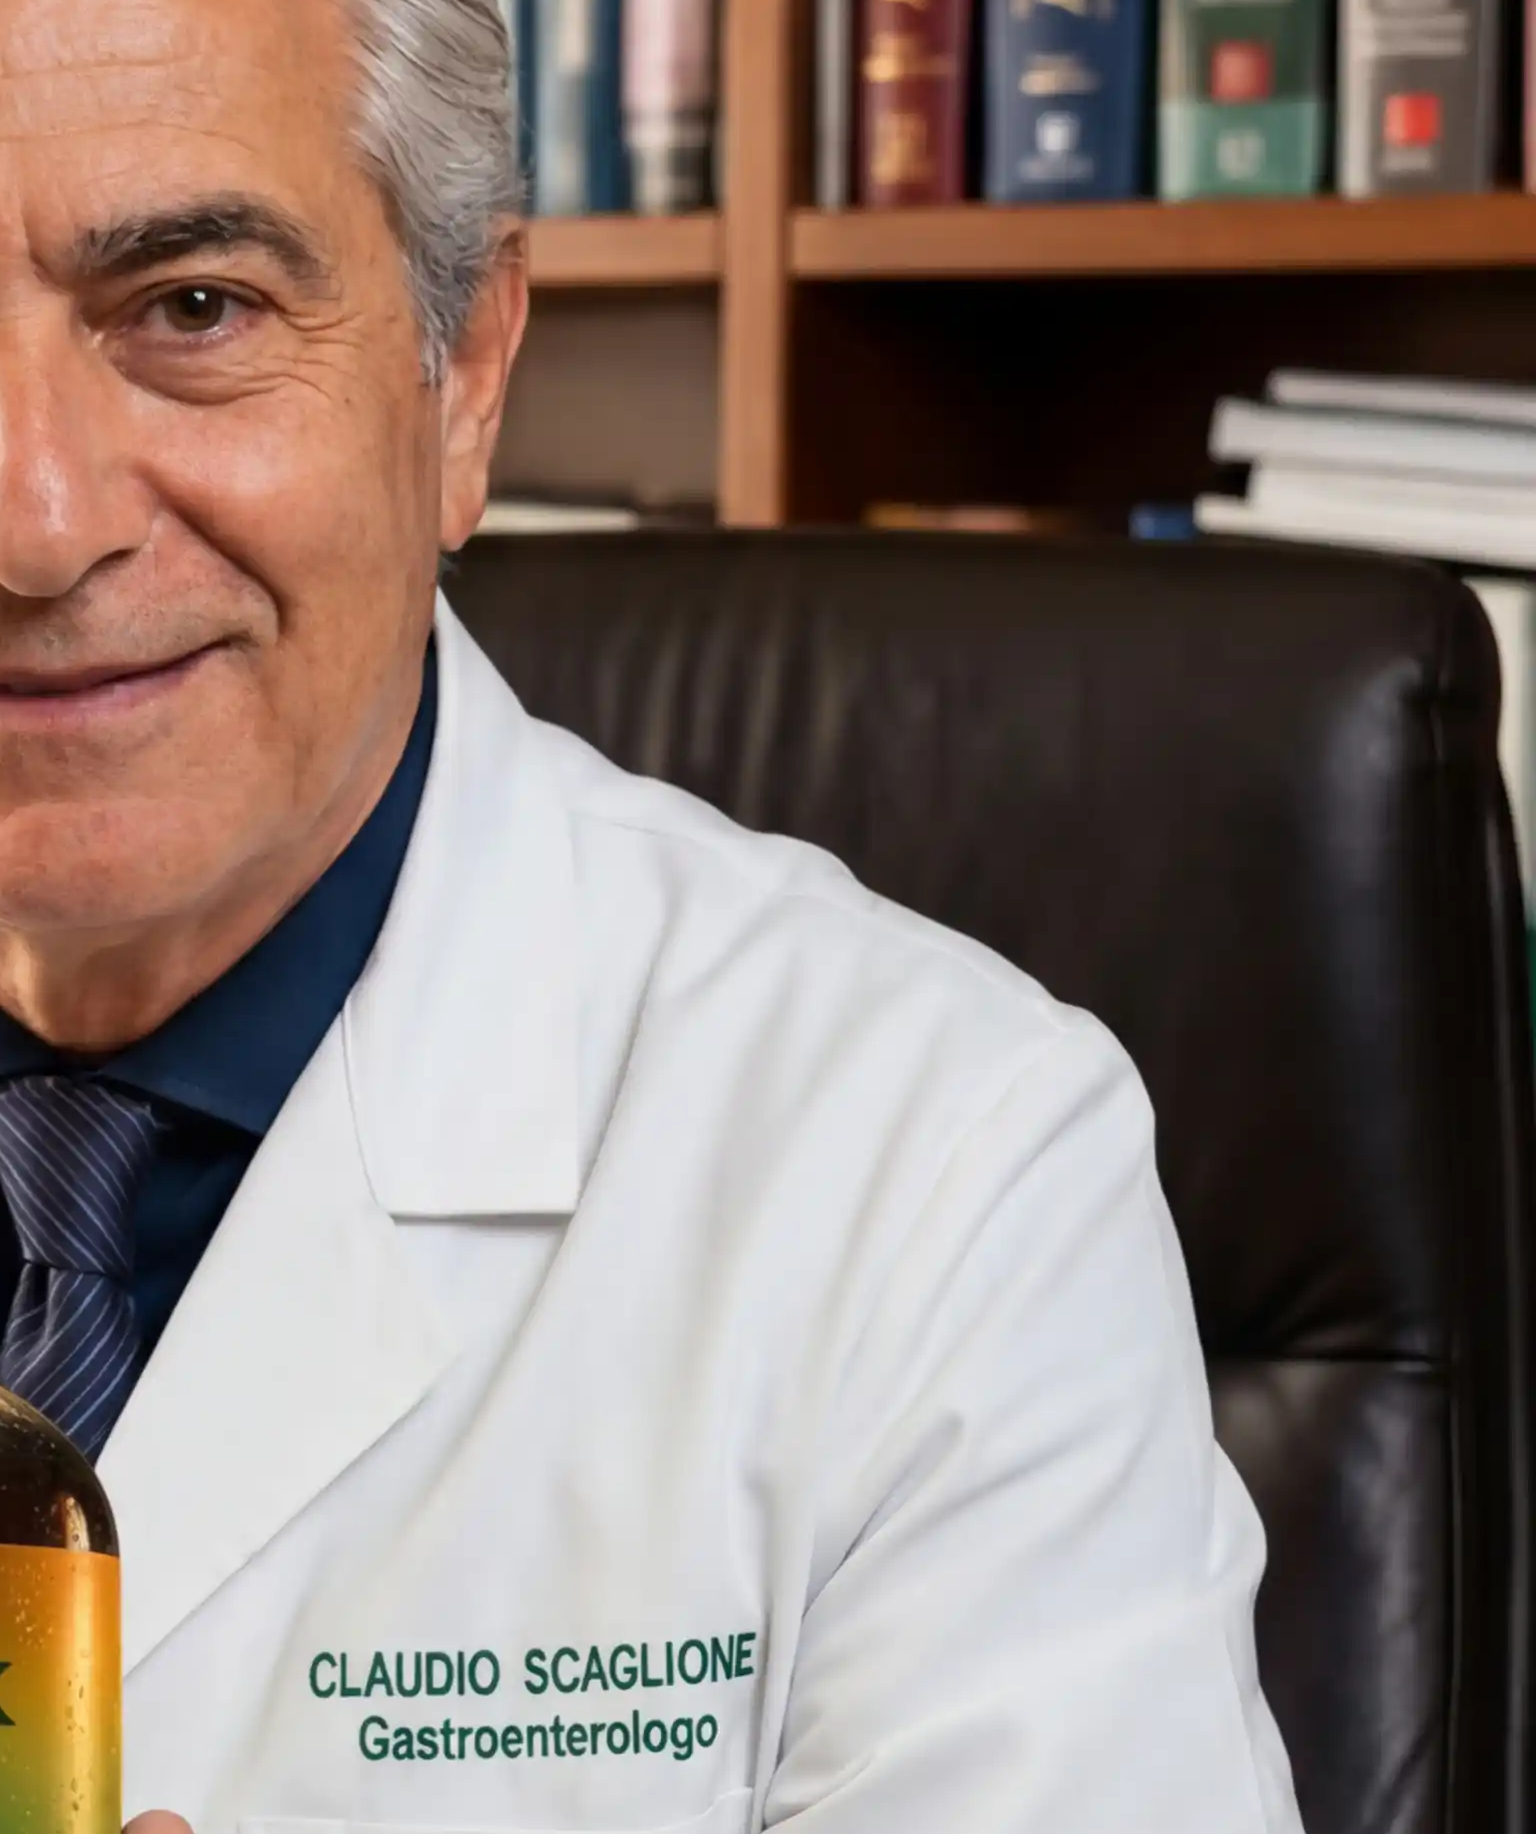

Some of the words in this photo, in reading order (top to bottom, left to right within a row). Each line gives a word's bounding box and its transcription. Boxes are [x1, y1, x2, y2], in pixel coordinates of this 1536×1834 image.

[309, 1649, 500, 1698] CLAUDIO
[524, 1631, 757, 1695] SCAGLIONE
[358, 1709, 719, 1761] Gastroenterologo
